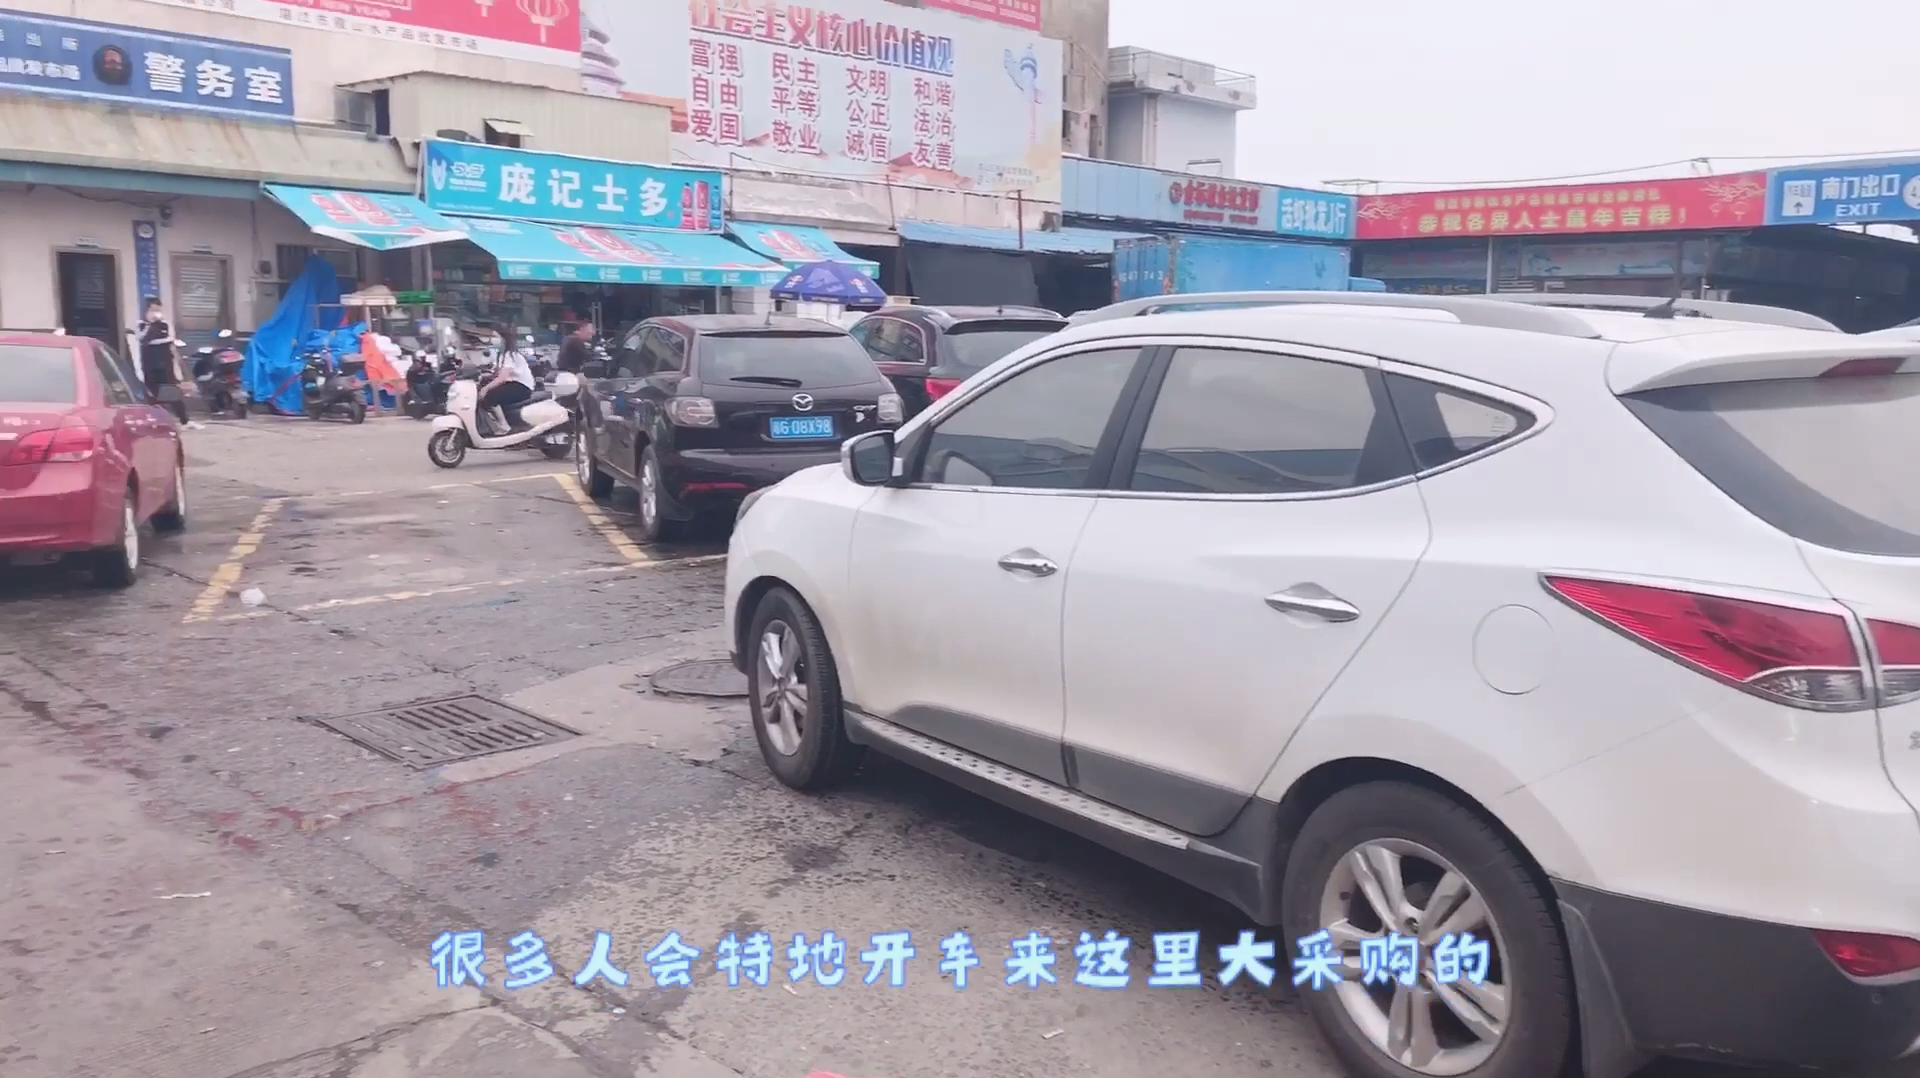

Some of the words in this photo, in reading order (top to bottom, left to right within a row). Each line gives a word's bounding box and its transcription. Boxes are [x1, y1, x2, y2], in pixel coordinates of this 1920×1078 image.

[690, 0, 953, 75] 社会主义核心价值观
[144, 51, 283, 104] 警务室
[689, 39, 739, 73] 富强
[772, 52, 817, 86] 民主
[846, 65, 887, 97] 文明
[914, 78, 952, 108] 和谐
[691, 74, 738, 108] 自由
[772, 87, 818, 118] 平等
[846, 99, 887, 128] 公正
[914, 108, 952, 137] 法治
[691, 110, 740, 142] 爱国
[772, 120, 819, 153] 敬业
[846, 129, 889, 162] 诚信
[914, 139, 953, 170] 友善
[498, 163, 667, 216] 庞记士多
[1822, 174, 1900, 200] 南门出口
[1836, 202, 1881, 216] EXIT
